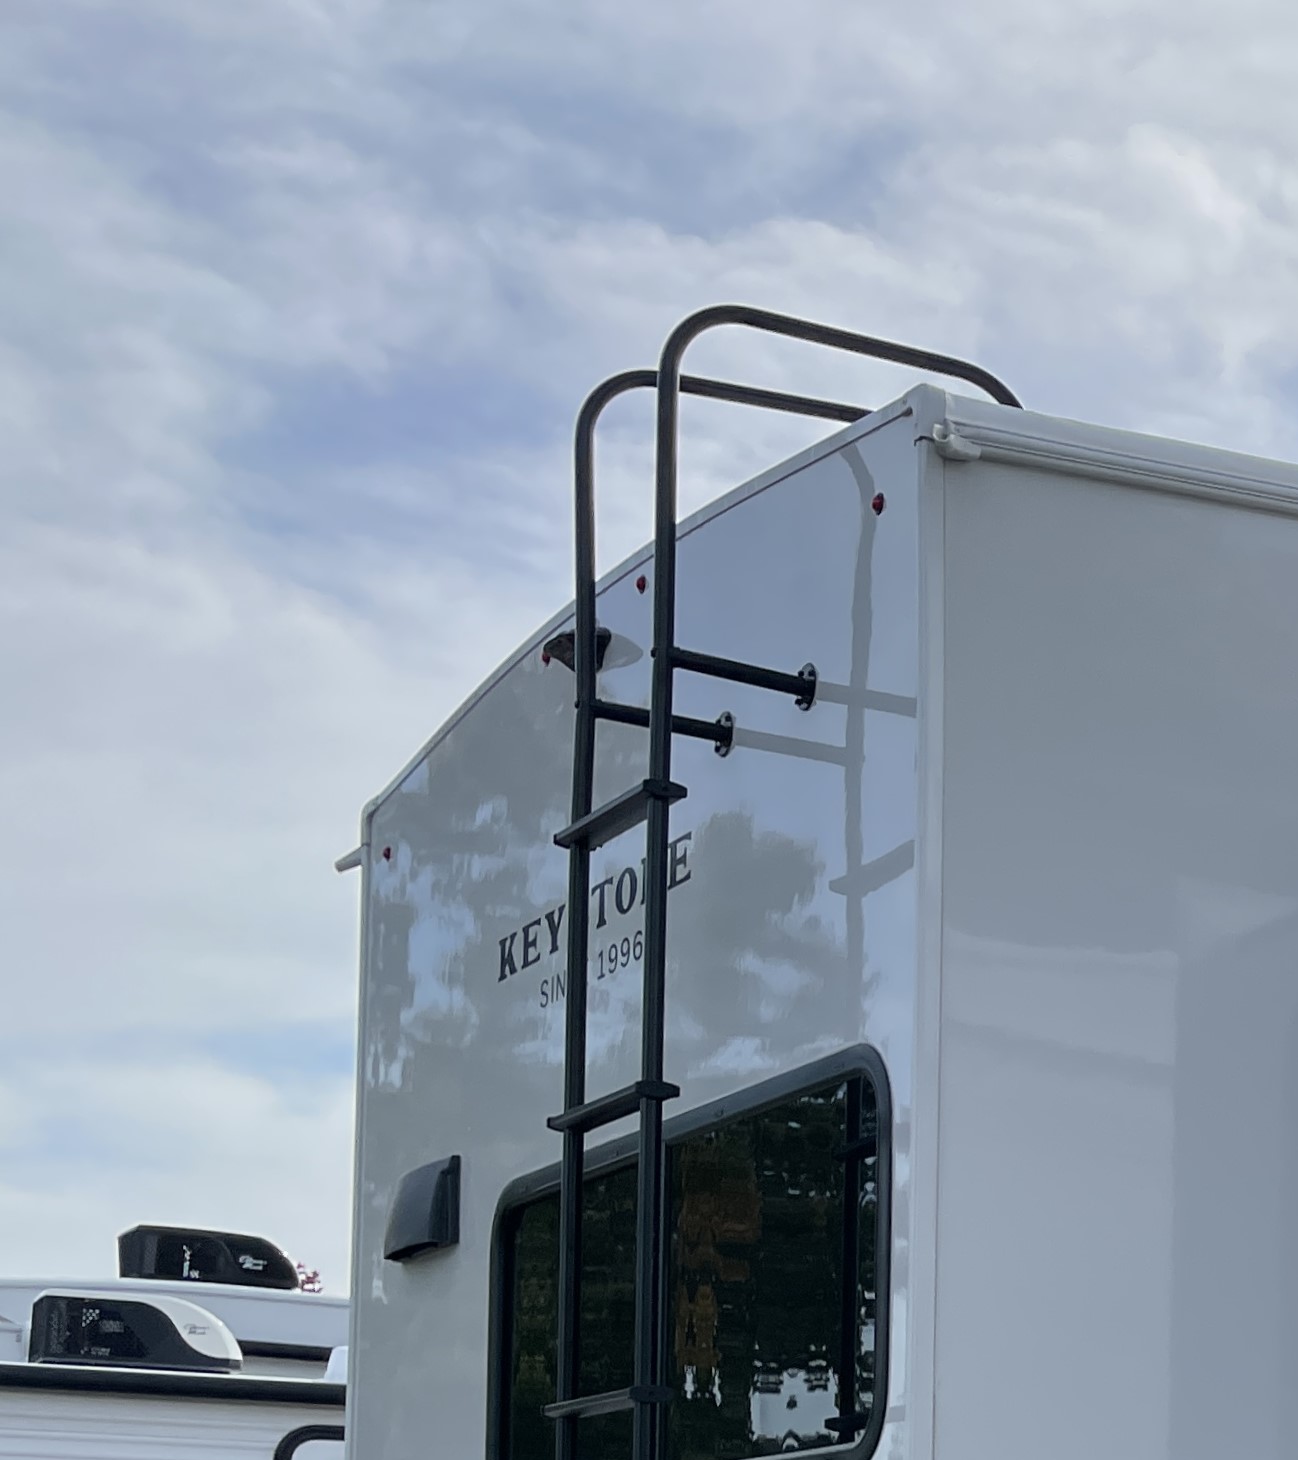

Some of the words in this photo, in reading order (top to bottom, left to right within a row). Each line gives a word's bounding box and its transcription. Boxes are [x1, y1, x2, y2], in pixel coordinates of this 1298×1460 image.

[497, 831, 692, 983] KEYTOE
[540, 962, 578, 1008] SIN
[597, 930, 643, 981] 1996
